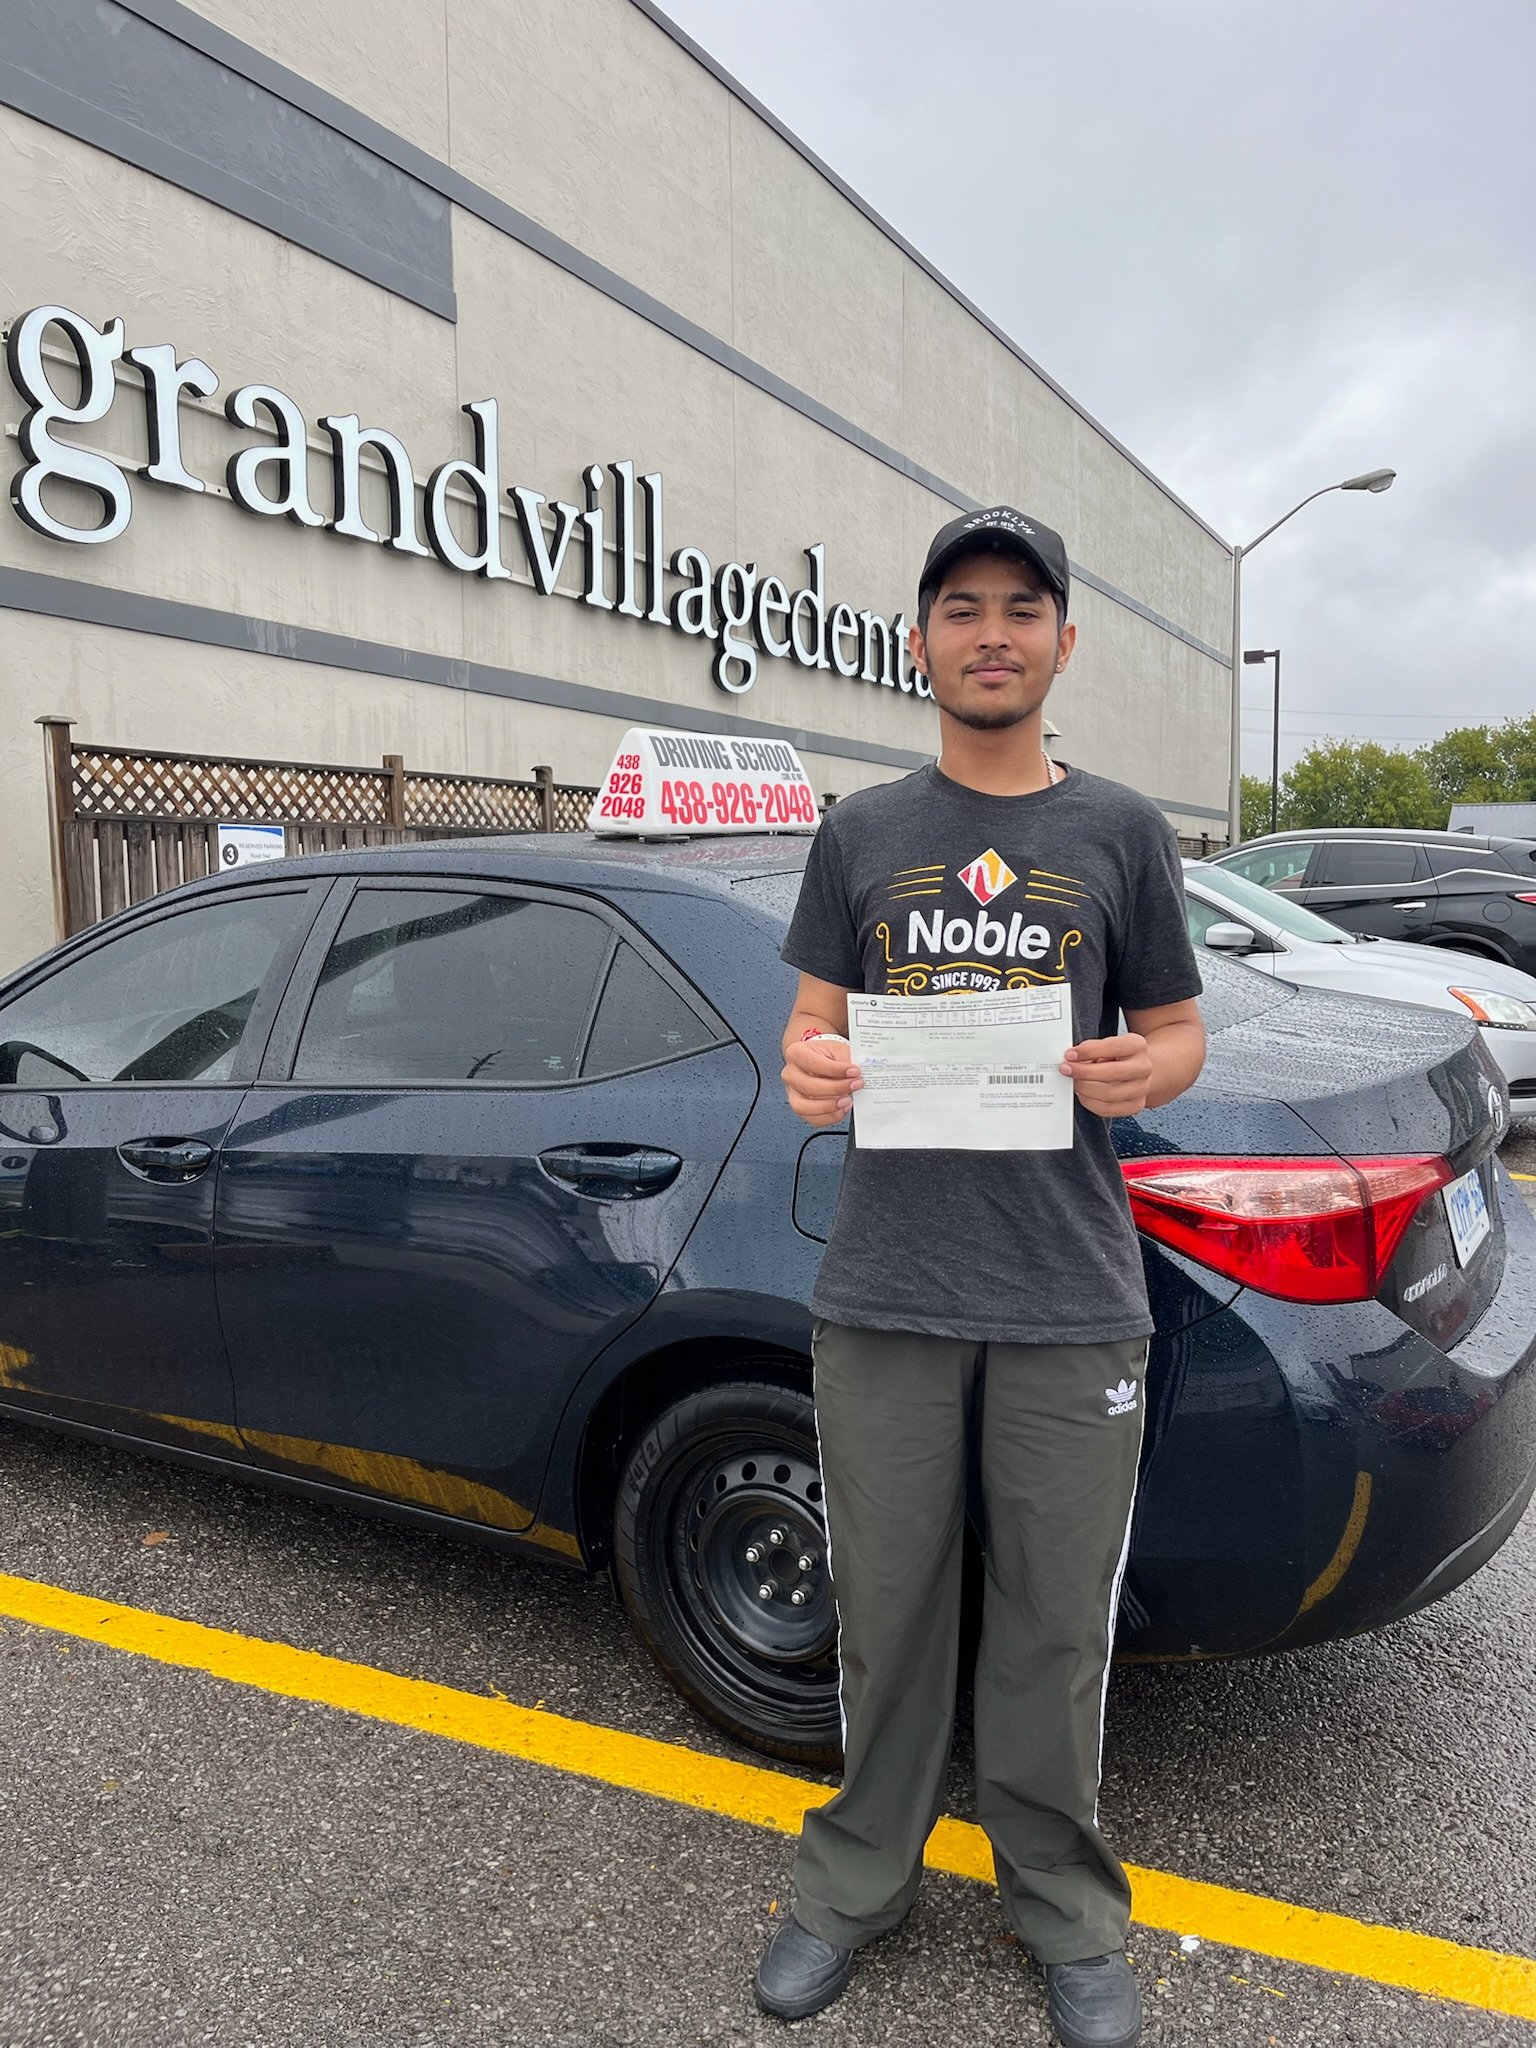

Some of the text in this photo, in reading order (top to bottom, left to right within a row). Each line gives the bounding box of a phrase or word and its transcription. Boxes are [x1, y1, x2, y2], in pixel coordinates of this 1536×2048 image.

[963, 510, 1036, 535] BROOKLYN
[617, 754, 640, 770] 438
[650, 736, 800, 772] DRIVING SCHOOL
[609, 773, 643, 795] 926
[600, 796, 646, 819] 2048
[661, 780, 815, 825] 438-926-2048
[226, 846, 235, 862] 3
[907, 909, 1051, 960] Noble
[931, 971, 1001, 992] SINCE 1993
[1107, 1399, 1137, 1416] adidas
